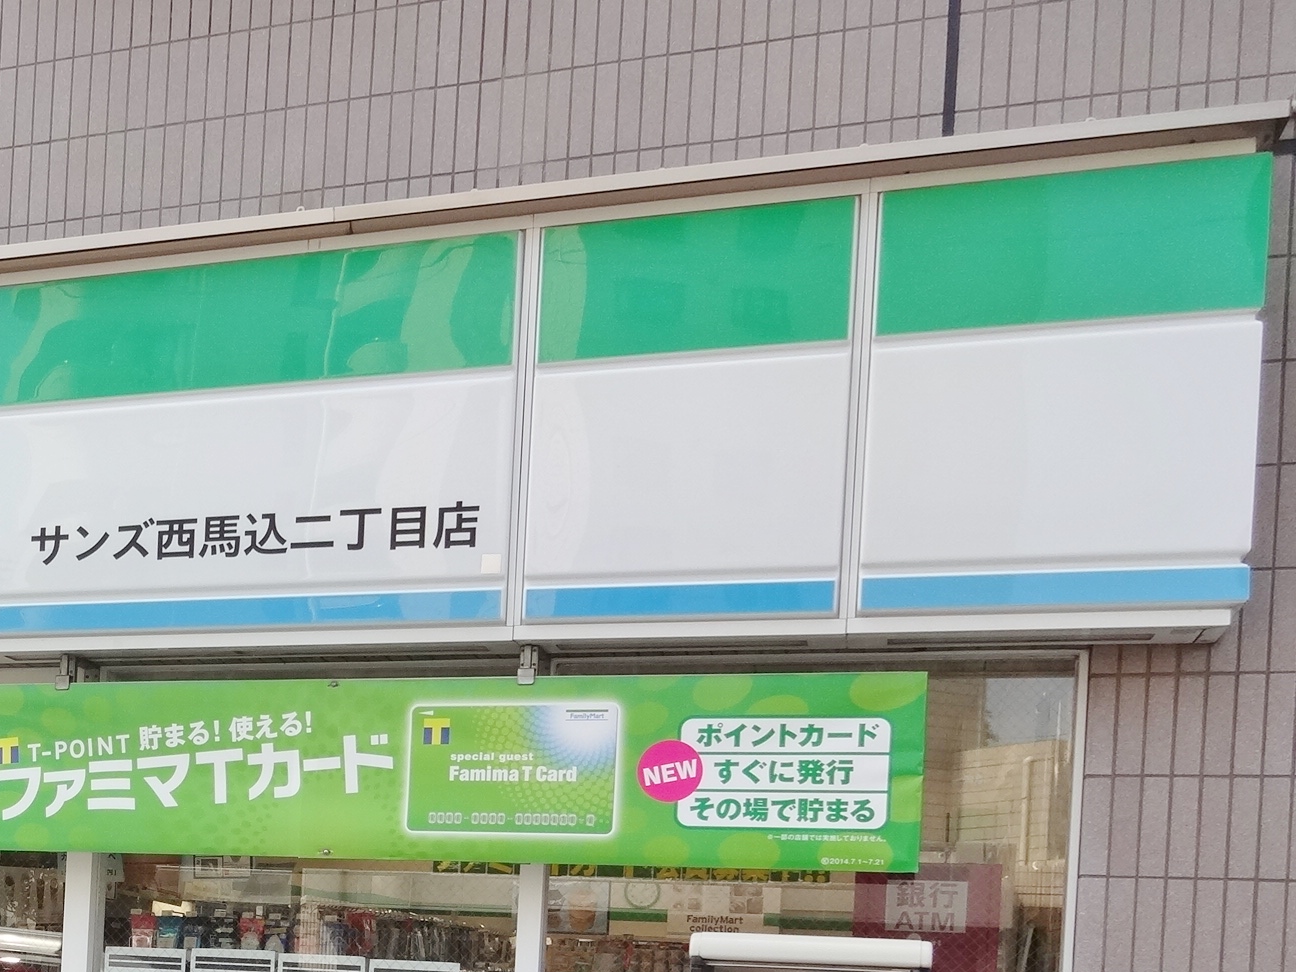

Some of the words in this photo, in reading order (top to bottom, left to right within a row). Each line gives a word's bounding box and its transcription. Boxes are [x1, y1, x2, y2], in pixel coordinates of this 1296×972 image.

[31, 500, 480, 566] サンズ西馬込二丁目店
[569, 712, 605, 720] FamilyMart
[27, 734, 130, 762] T-POINT
[696, 723, 880, 748] ポイントカード
[450, 752, 495, 762] special
[499, 752, 534, 762] guest
[449, 766, 519, 782] Famima
[522, 766, 533, 782] T
[536, 766, 577, 782] Card
[643, 758, 698, 787] NEW
[714, 759, 854, 785] すぐに発行
[690, 797, 875, 823] その場で貯まる
[896, 881, 958, 909] 銀行
[686, 914, 744, 925] FamilyMart
[689, 924, 739, 933] collection
[894, 911, 954, 931] ATM
